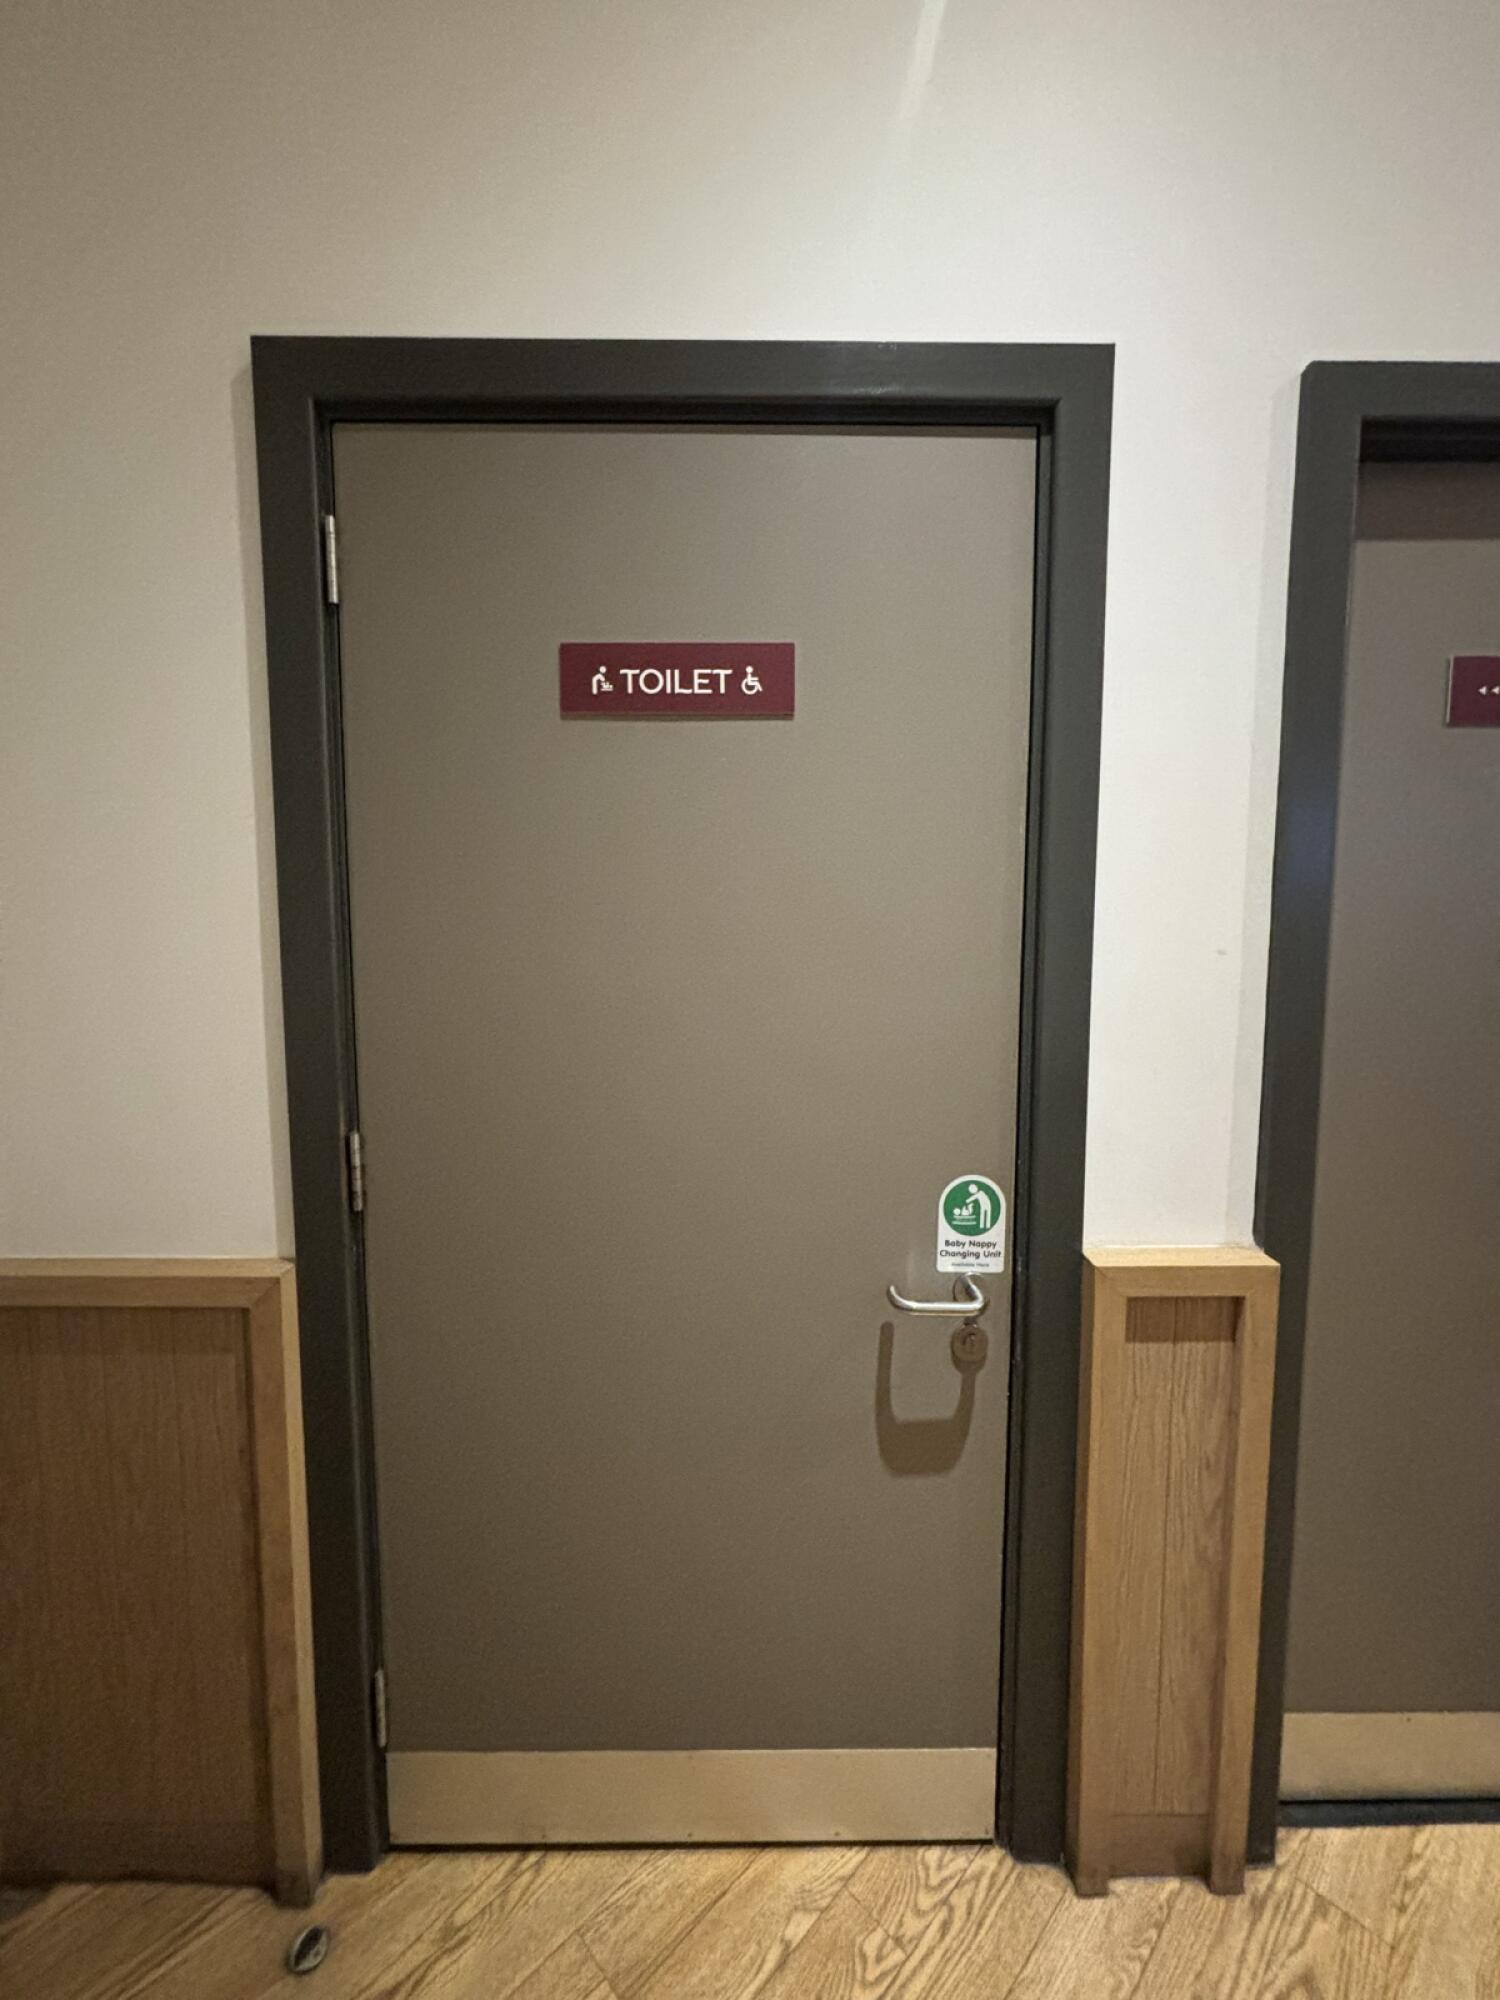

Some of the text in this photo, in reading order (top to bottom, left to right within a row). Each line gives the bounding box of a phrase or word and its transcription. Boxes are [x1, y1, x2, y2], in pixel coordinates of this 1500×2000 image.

[619, 668, 733, 695] TOILET
[944, 1240, 997, 1249] Baby Nappy
[939, 1250, 1001, 1260] Changing Unit
